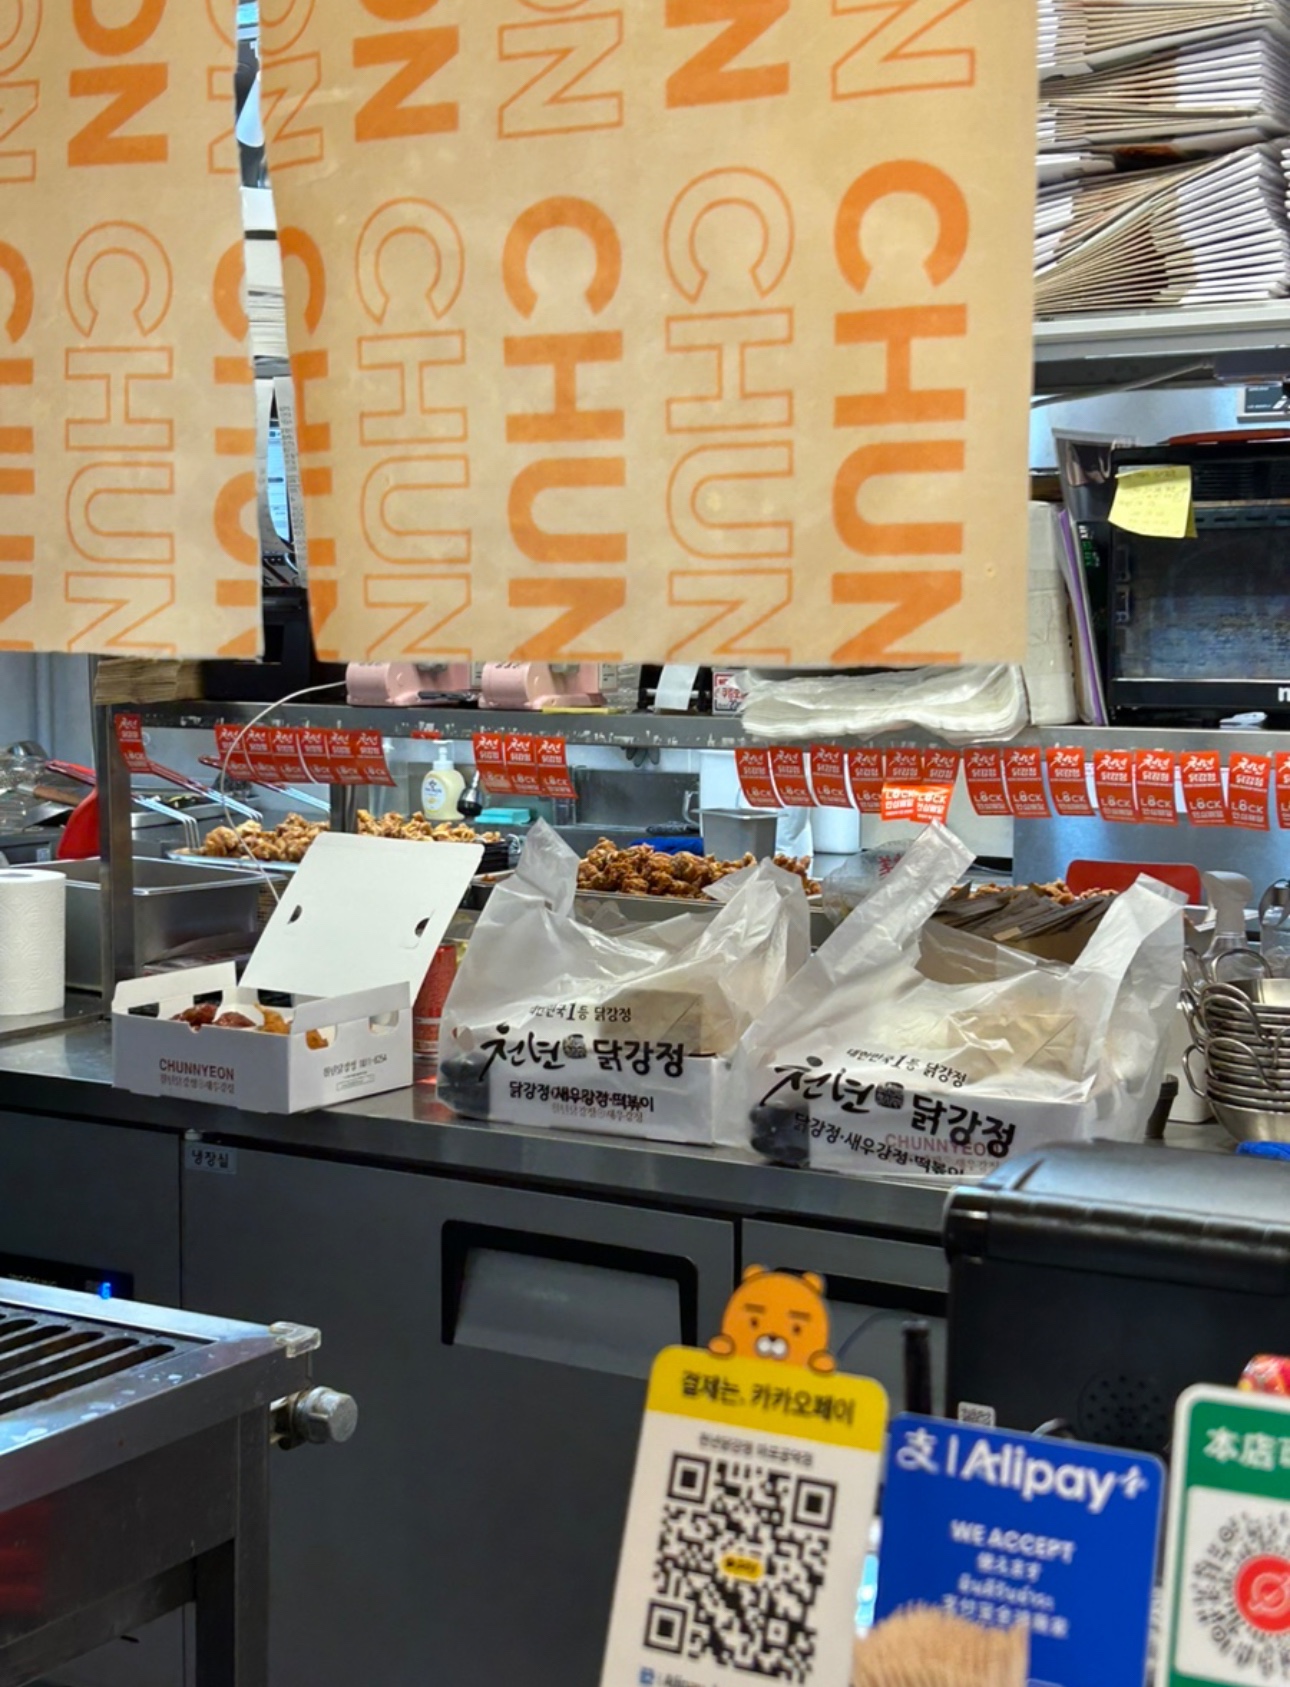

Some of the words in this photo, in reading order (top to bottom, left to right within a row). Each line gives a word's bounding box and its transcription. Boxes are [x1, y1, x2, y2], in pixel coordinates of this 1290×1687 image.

[353, 0, 459, 142] N
[356, 197, 471, 660] CHUN
[502, 196, 627, 661] CHUN
[663, 166, 794, 661] CHUN
[831, 159, 970, 663] CHUN
[594, 1005, 632, 1022] 닭강정
[159, 1058, 235, 1081] CHUNNYEON
[478, 1023, 566, 1082] 천년
[593, 1039, 684, 1078] 닭강정
[924, 1060, 967, 1088] 닭강정
[759, 1055, 876, 1115] 천년
[911, 1094, 1017, 1158] 닭강정
[191, 1149, 229, 1168] 냉장실
[885, 1133, 1001, 1158] CHUNNYEO
[752, 1383, 857, 1426] 카카오페이
[950, 1519, 986, 1548] WE
[987, 1527, 1077, 1564] ACCEPT
